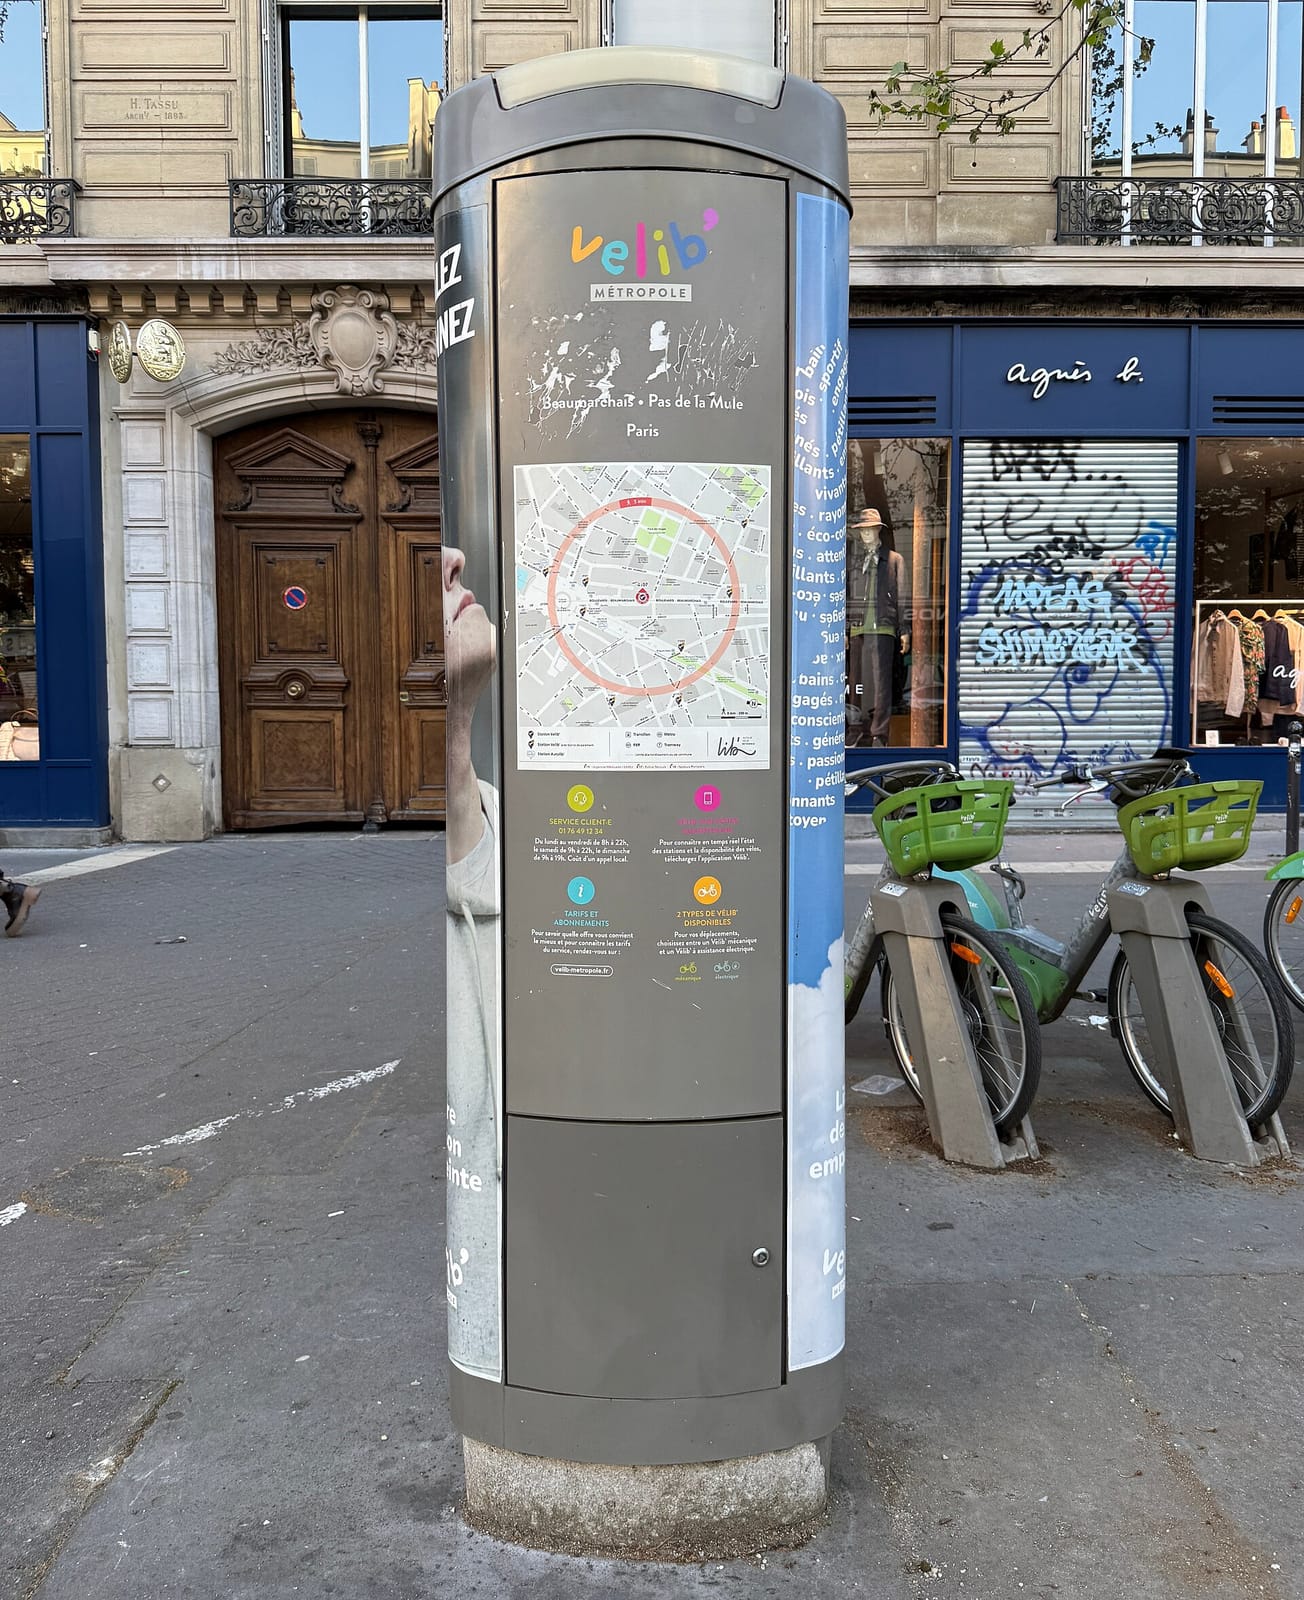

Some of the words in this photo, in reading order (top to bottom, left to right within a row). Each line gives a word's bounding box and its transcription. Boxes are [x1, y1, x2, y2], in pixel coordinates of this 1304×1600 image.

[130, 97, 141, 110] H.
[594, 284, 687, 298] MÉTROPOLE
[1006, 360, 1092, 399] agnès
[1116, 356, 1145, 383] b.
[543, 394, 634, 410] Beaumarchais
[649, 394, 671, 408] Pas
[675, 394, 691, 408] de
[695, 394, 706, 409] la
[710, 395, 744, 410] Mule
[626, 424, 660, 437] Paris
[535, 837, 543, 845] Du
[568, 838, 592, 846] vendredi
[615, 839, 629, 847] 22h,
[659, 838, 673, 846] Pour
[674, 838, 701, 846] connaître
[700, 846, 734, 855] disponibilité
[596, 856, 612, 865] appel
[698, 854, 732, 863] l'application
[564, 910, 588, 918] TARIFS
[589, 910, 599, 918] ET
[682, 910, 704, 918] TYPES
[554, 919, 610, 927] ABONNEMENTS
[684, 918, 732, 927] DISPONIBLES
[545, 929, 561, 937] savoir
[561, 930, 579, 939] quelle
[699, 930, 740, 939] déplacements,
[564, 940, 577, 948] pour
[727, 937, 757, 945] mécanique
[551, 947, 572, 955] service,
[573, 947, 607, 955] rendez-vous
